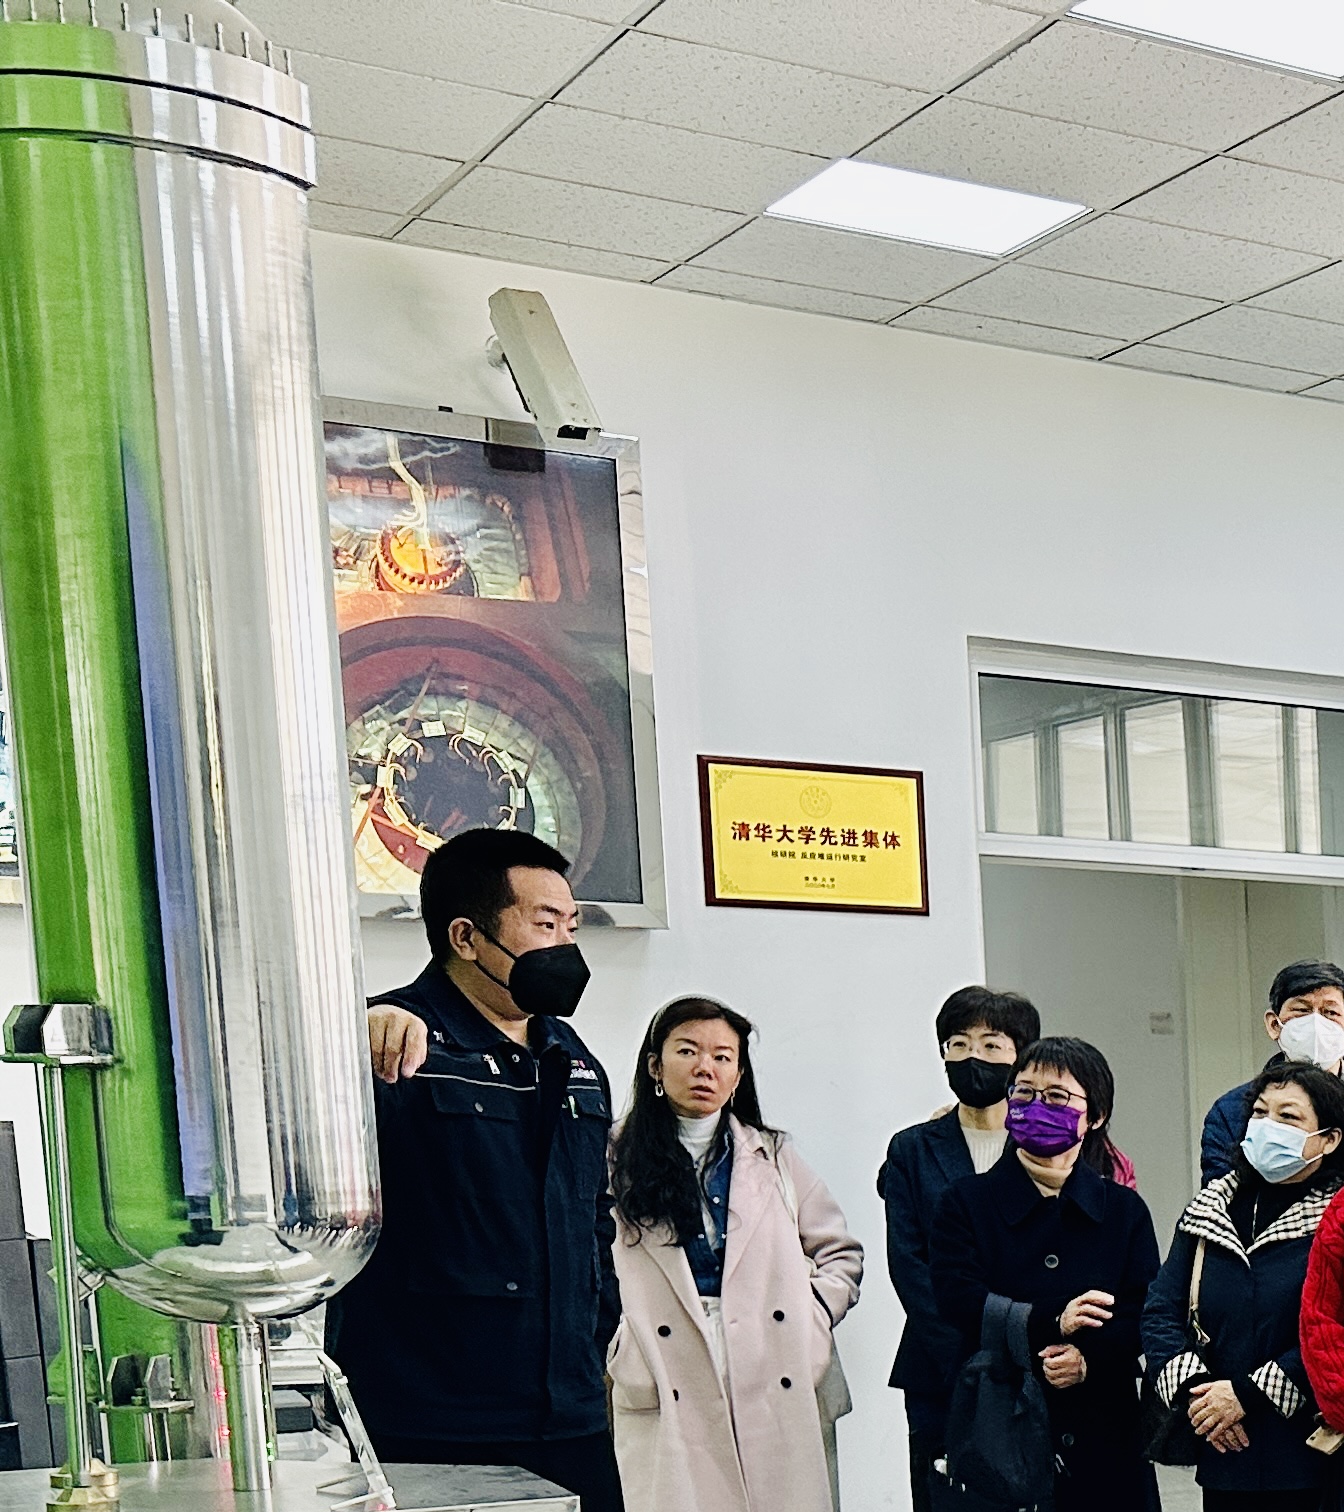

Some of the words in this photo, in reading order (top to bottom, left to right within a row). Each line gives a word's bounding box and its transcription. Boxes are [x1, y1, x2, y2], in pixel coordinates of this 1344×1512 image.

[731, 820, 901, 851] 清华大学先进集体
